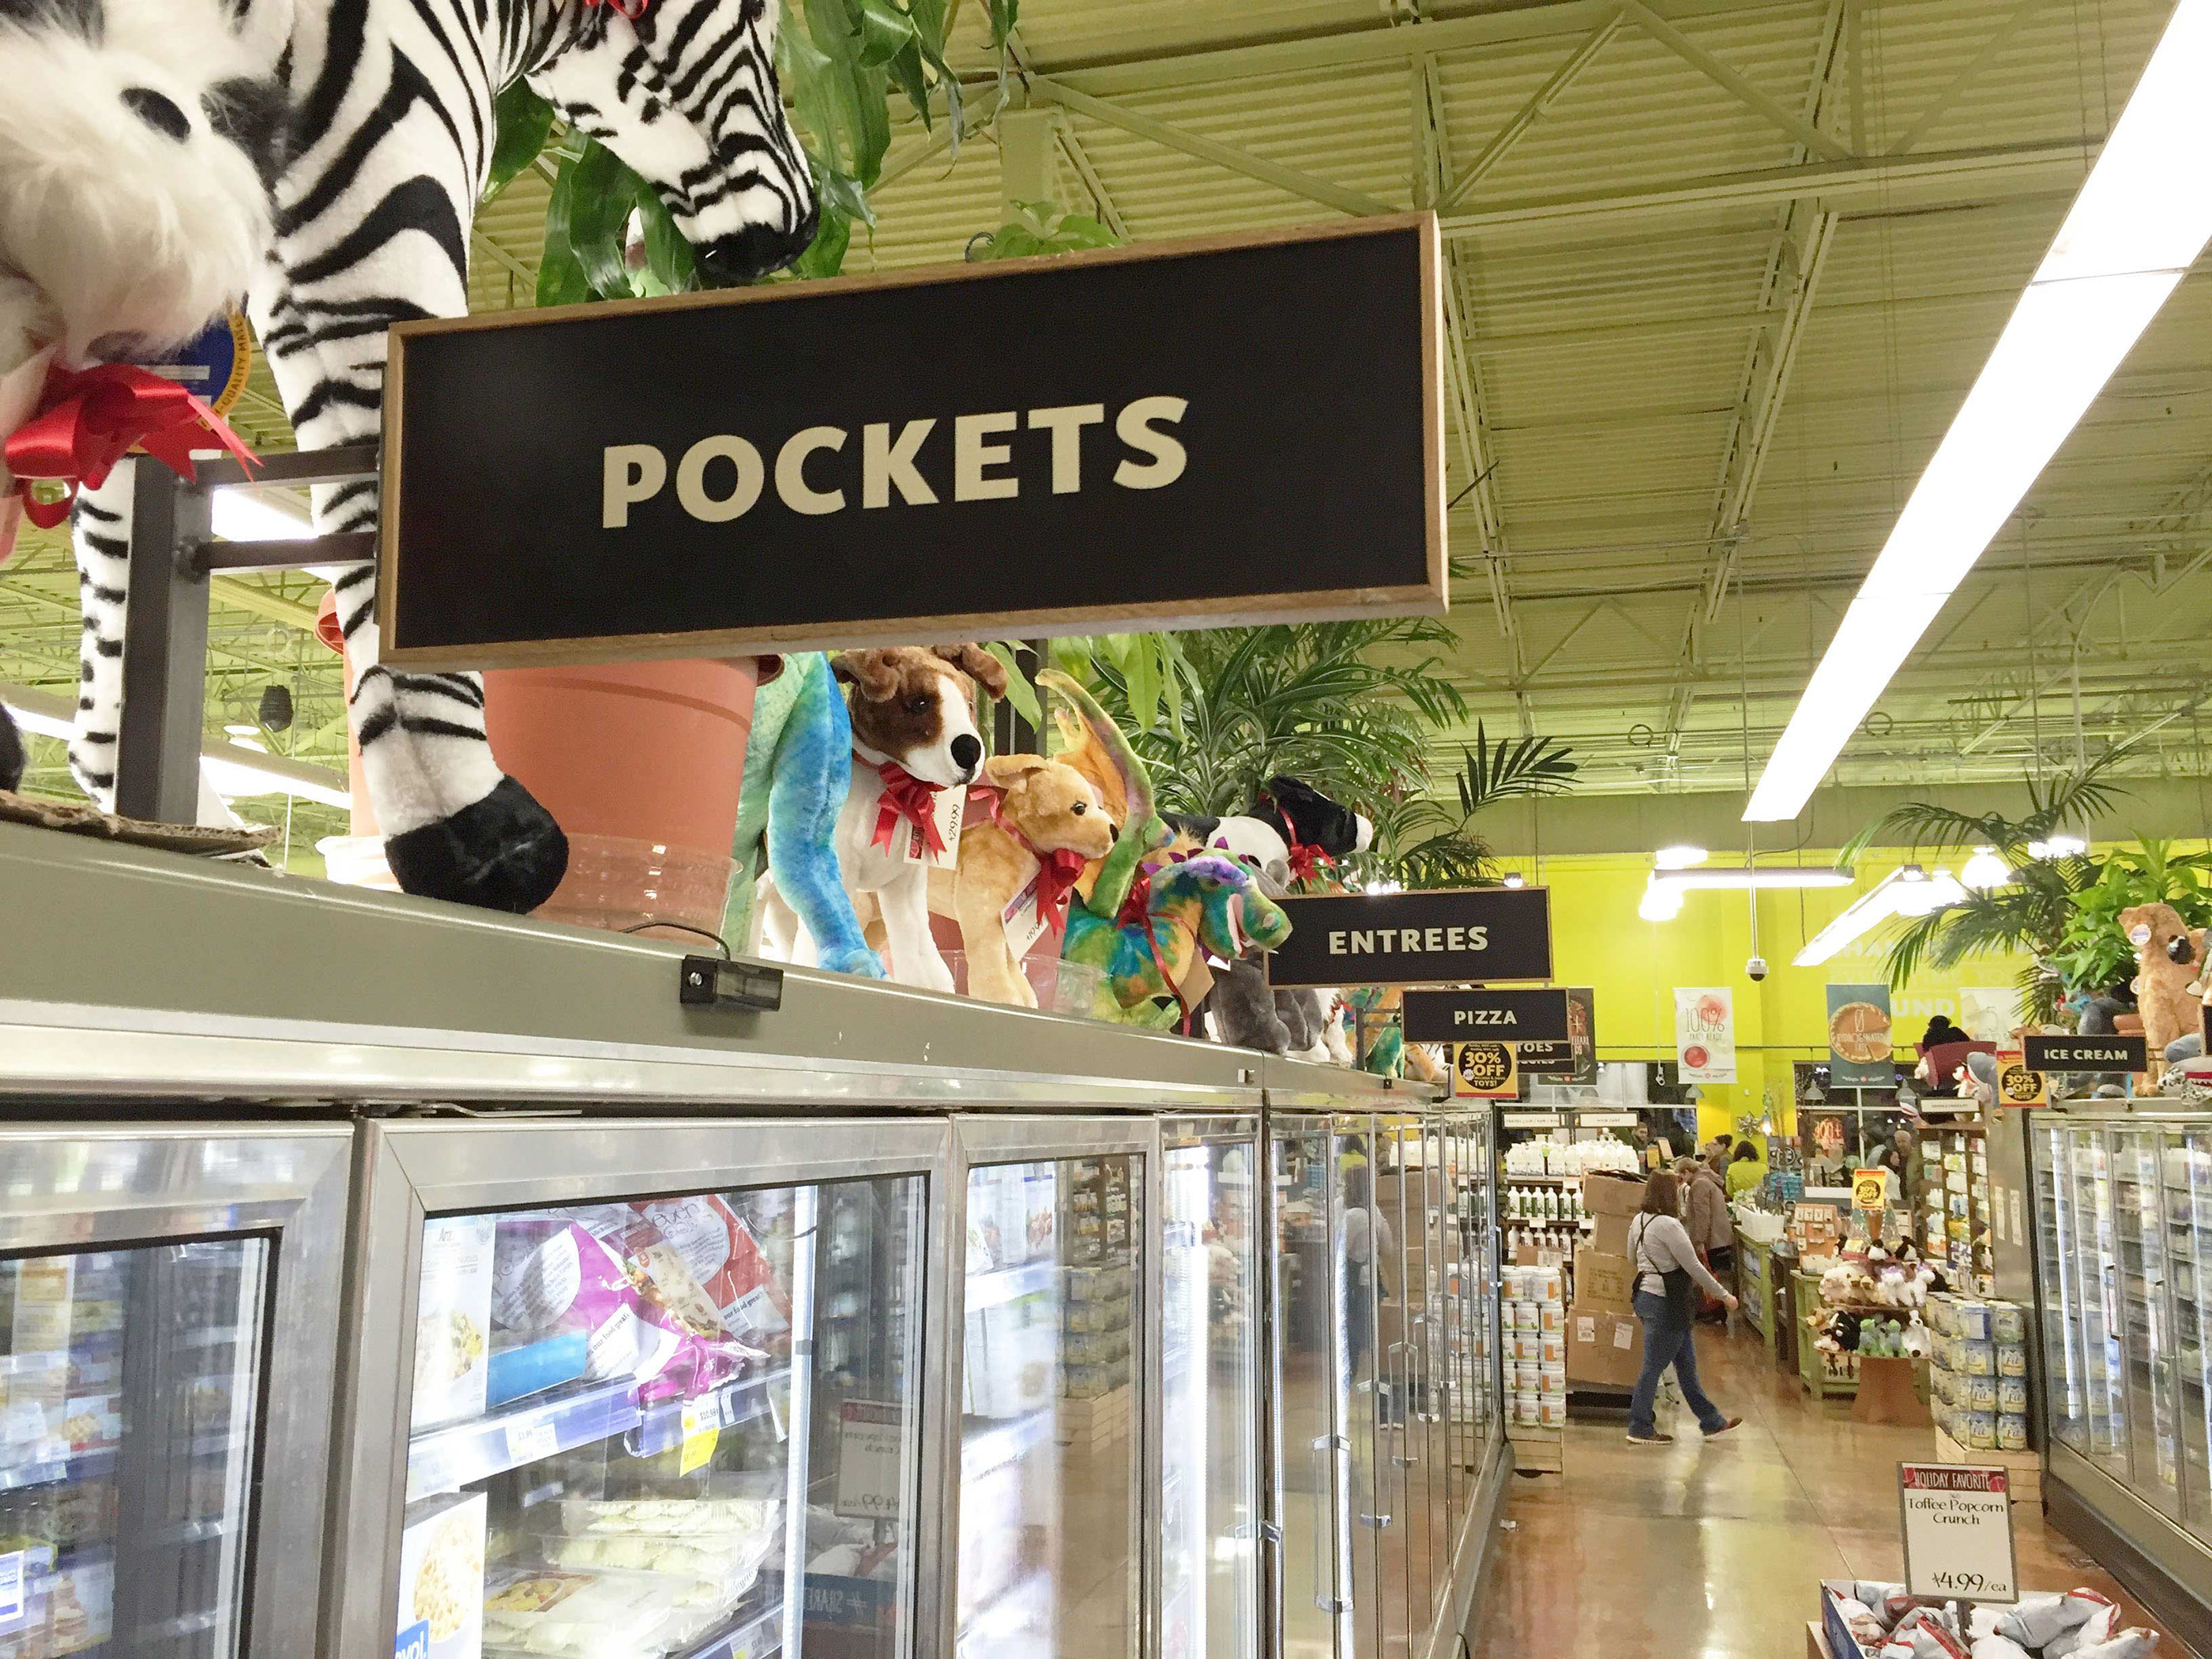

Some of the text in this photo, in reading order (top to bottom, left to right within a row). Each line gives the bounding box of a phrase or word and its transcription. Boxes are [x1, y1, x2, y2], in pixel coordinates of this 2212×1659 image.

[602, 395, 1189, 529] POCKETS
[1329, 926, 1488, 954] ENTREES
[1893, 997, 1955, 1017] UND
[1454, 1010, 1518, 1025] PIZZA
[1685, 1007, 1725, 1033] 100%
[1517, 1043, 1554, 1053] TOES
[2044, 1049, 2128, 1061] ICE CREAM
[1465, 1051, 1502, 1067] 30%
[1473, 1064, 1505, 1076] OFF
[2006, 1074, 2034, 1086] 30%
[2013, 1083, 2037, 1092] OFF
[1914, 1470, 1991, 1490] HOLIDAY FAVORITE
[1906, 1497, 2004, 1513] Toffee Popcorn
[1933, 1512, 1981, 1525] Crunch
